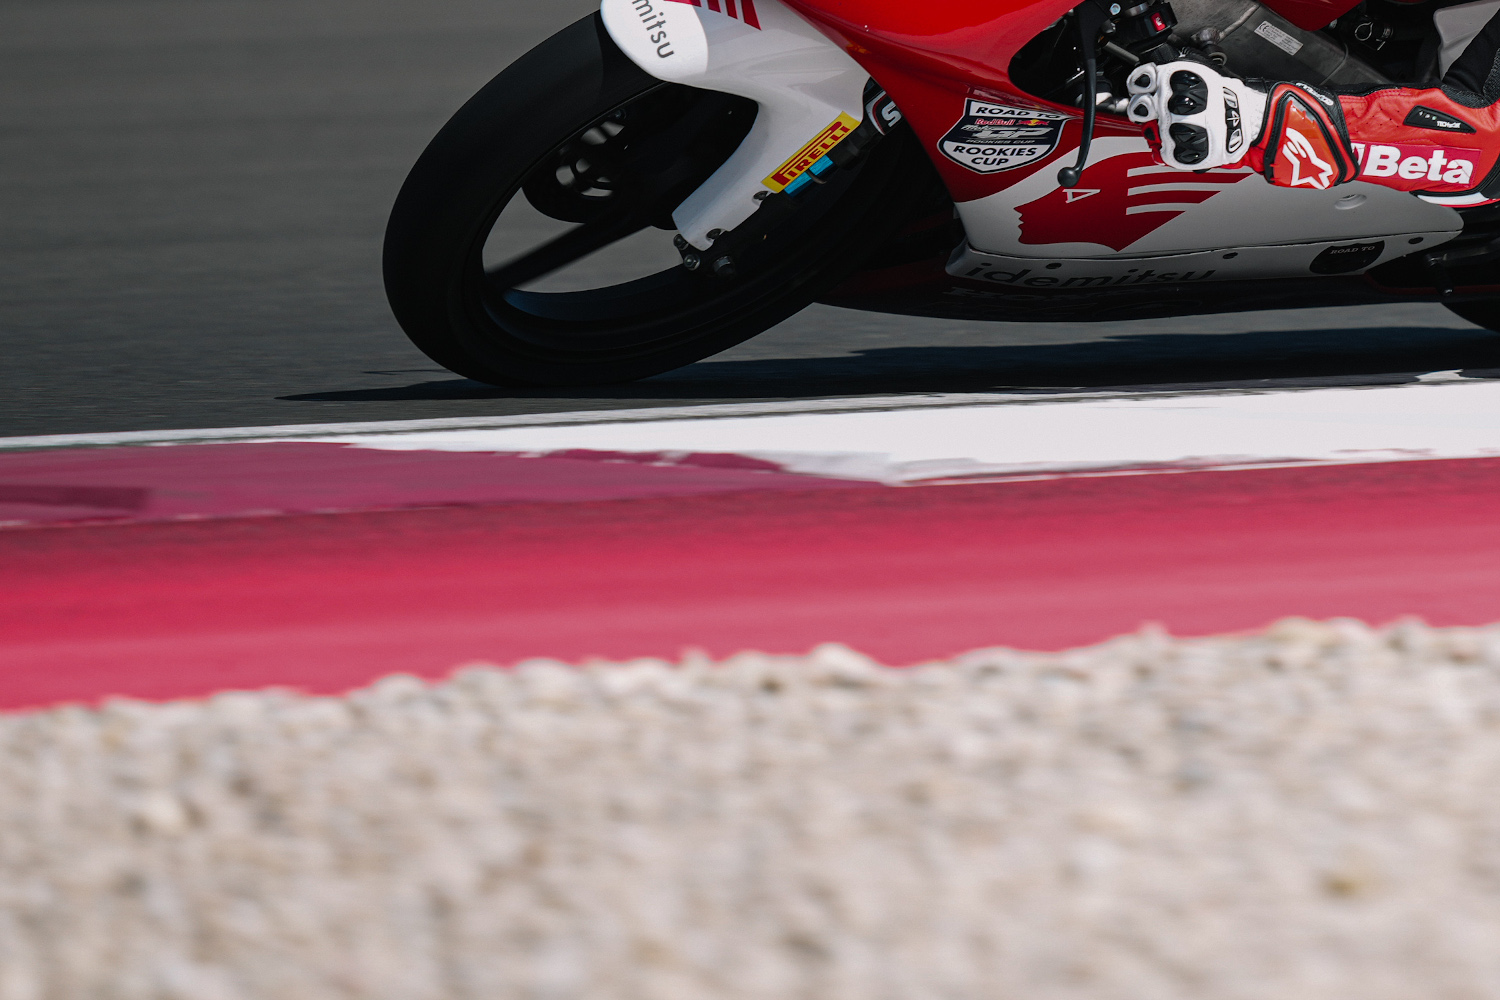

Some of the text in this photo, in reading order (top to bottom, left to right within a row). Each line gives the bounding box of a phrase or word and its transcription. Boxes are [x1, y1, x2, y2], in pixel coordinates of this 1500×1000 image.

[975, 106, 1030, 116] ROAD
[771, 121, 851, 186] PIRELLI
[952, 145, 1038, 157] ROOKIES
[971, 157, 1010, 166] CUP
[1362, 144, 1474, 184] Beta
[964, 262, 1217, 288] idemitsu
